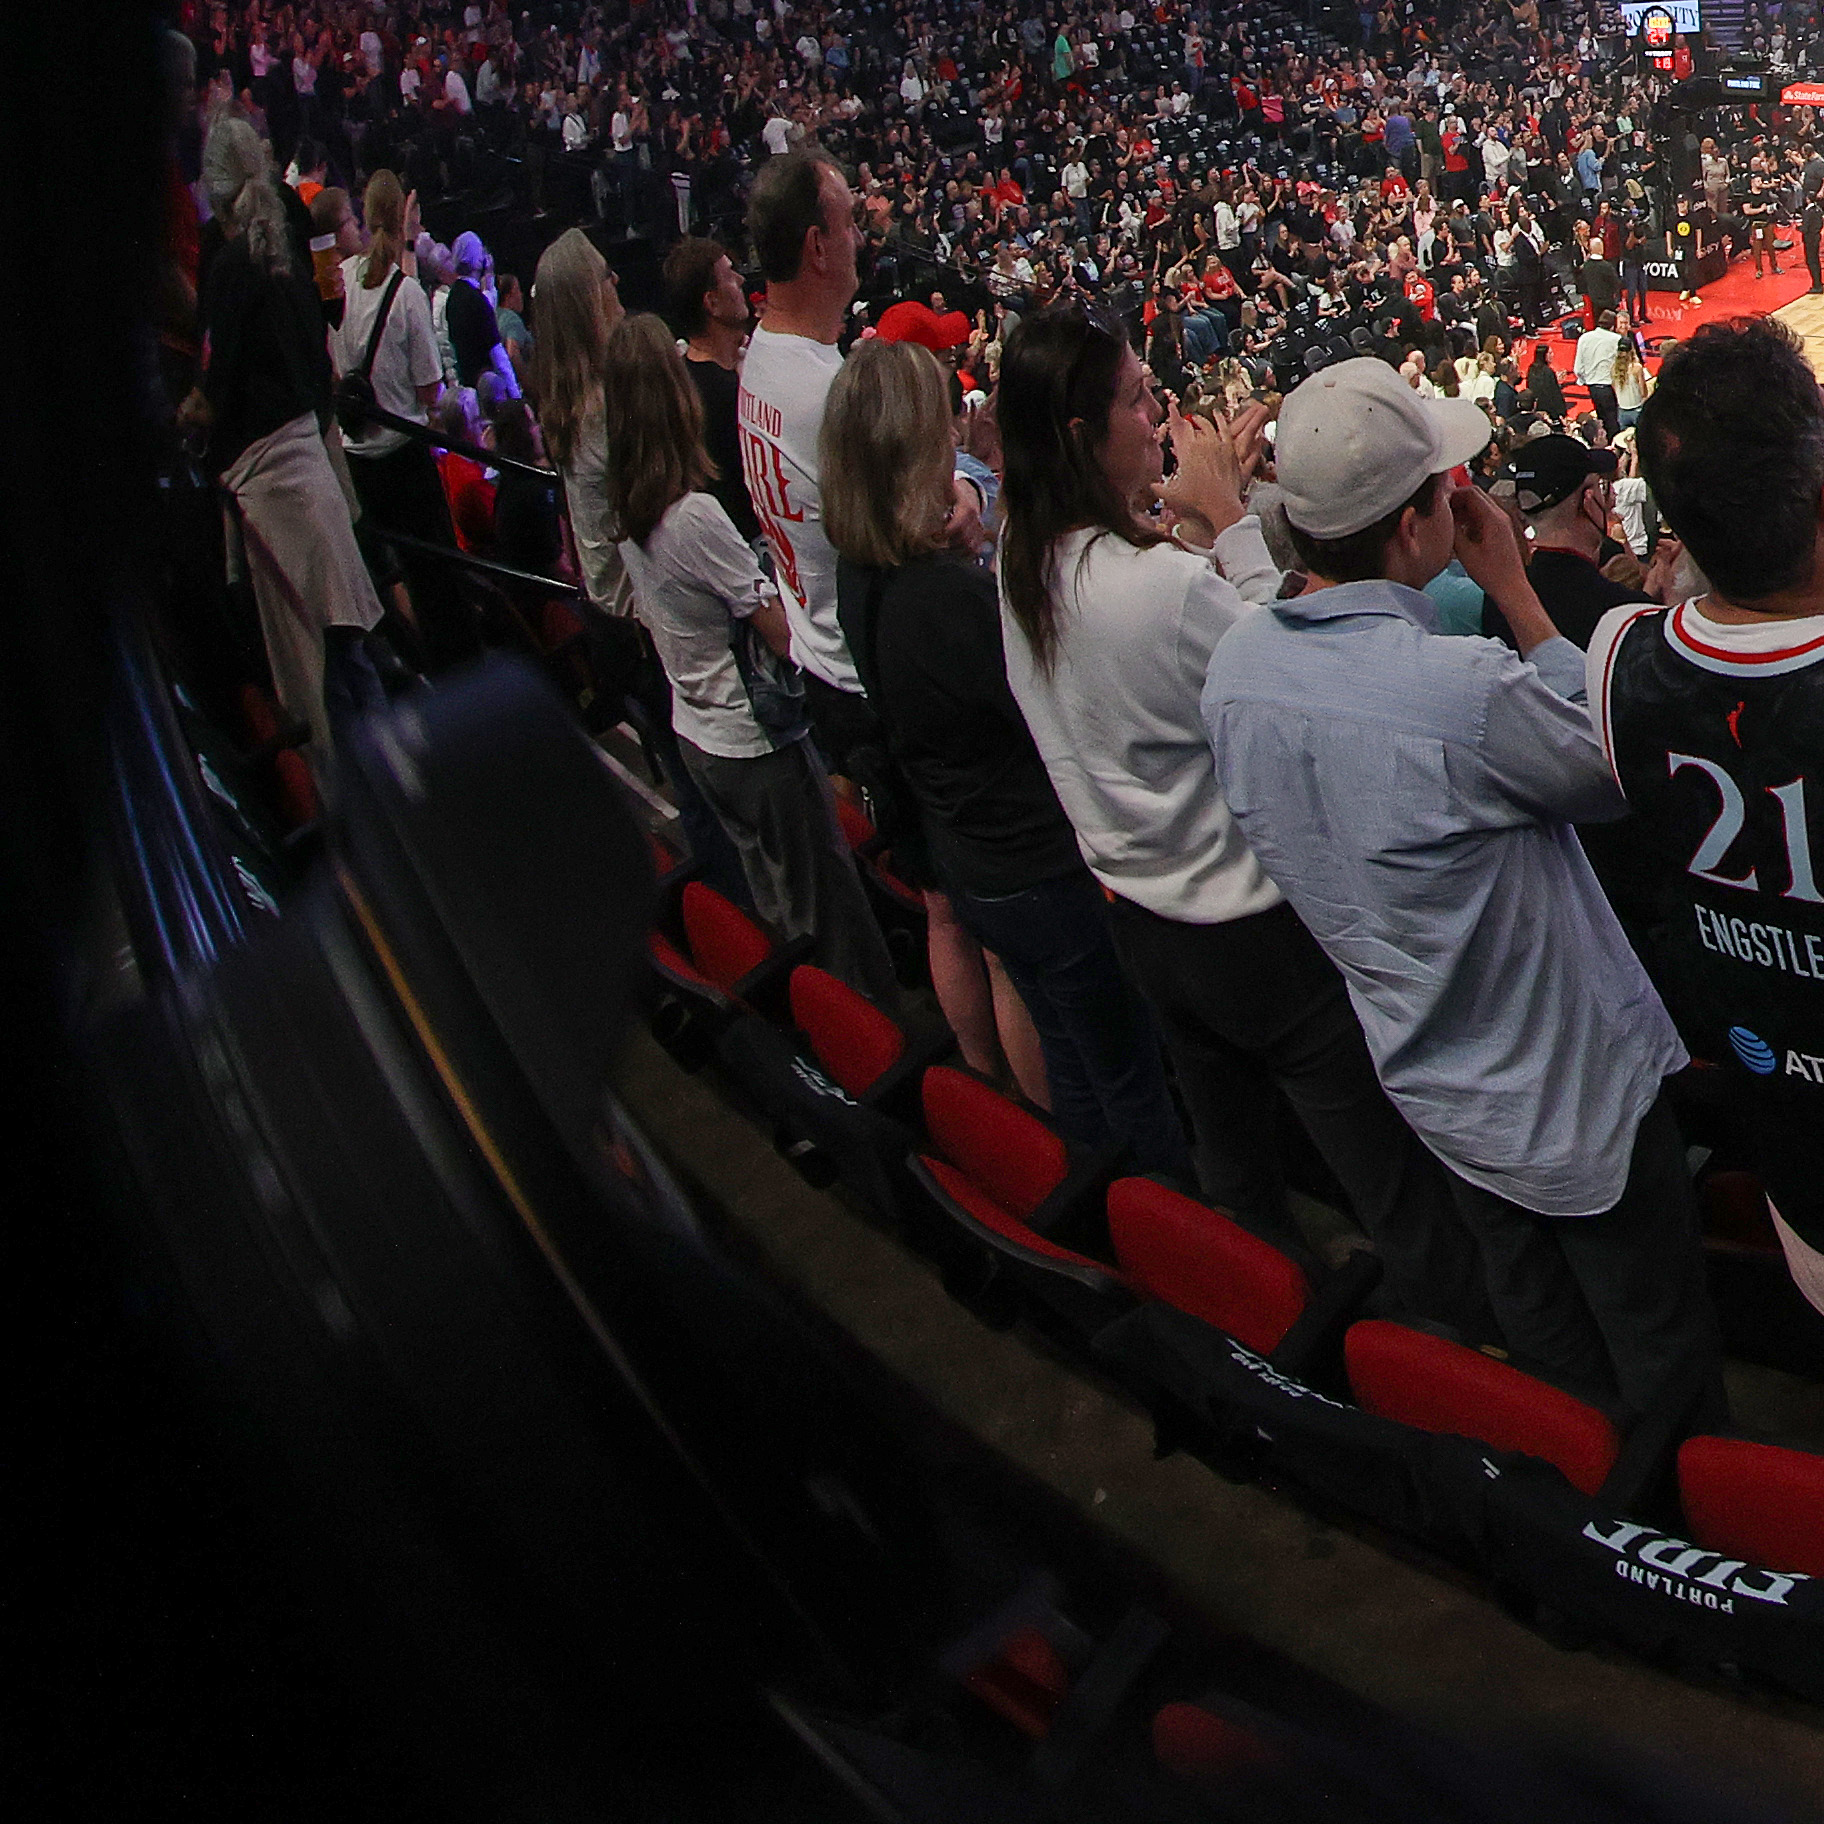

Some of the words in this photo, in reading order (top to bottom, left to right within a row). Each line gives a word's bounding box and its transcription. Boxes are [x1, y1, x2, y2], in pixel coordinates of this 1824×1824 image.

[1642, 262, 1678, 279] YOTA
[738, 385, 782, 439] TLAND
[738, 423, 804, 523] IRE
[1616, 1558, 1735, 1614] PORTLAND
